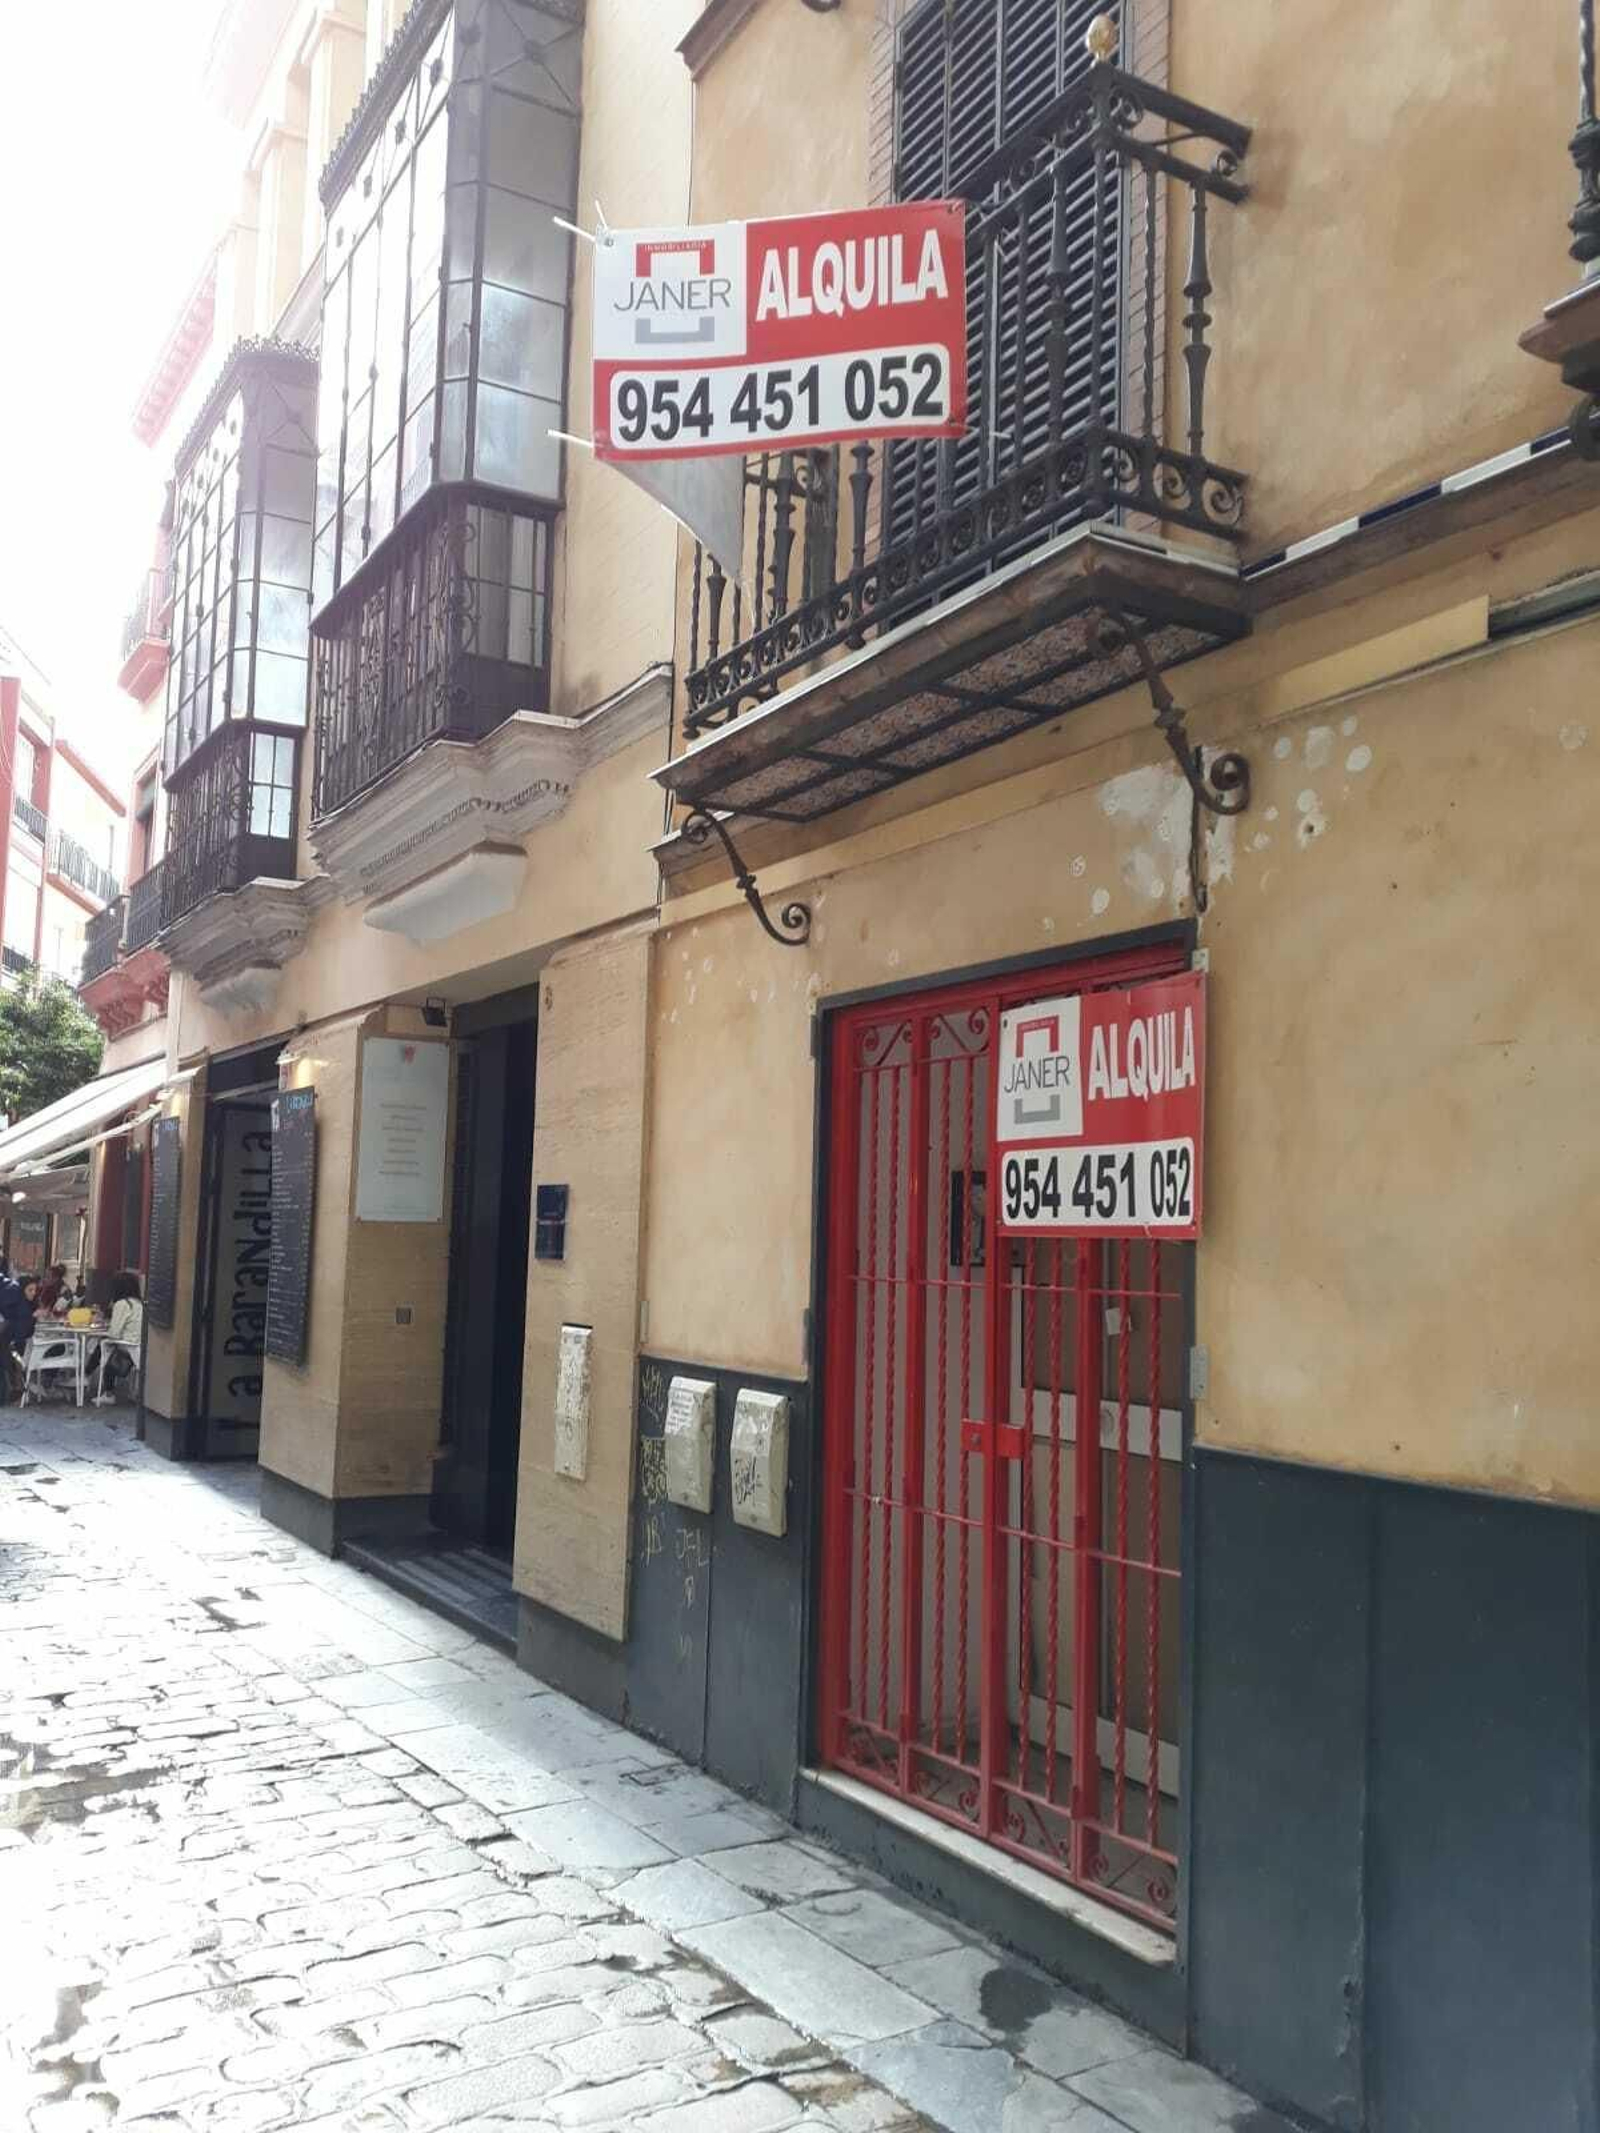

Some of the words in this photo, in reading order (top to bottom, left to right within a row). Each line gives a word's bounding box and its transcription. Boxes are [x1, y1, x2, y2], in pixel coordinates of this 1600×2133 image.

[614, 278, 731, 312] JANER
[755, 229, 949, 322] ALQUILA
[618, 377, 713, 442] 954
[731, 365, 820, 433] 451
[845, 353, 943, 421] 052
[1004, 1056, 1070, 1093] JANER
[1088, 1007, 1195, 1101] ALQUILA
[1006, 1156, 1061, 1219] 954
[1073, 1152, 1136, 1218] 451
[1151, 1147, 1190, 1217] 052
